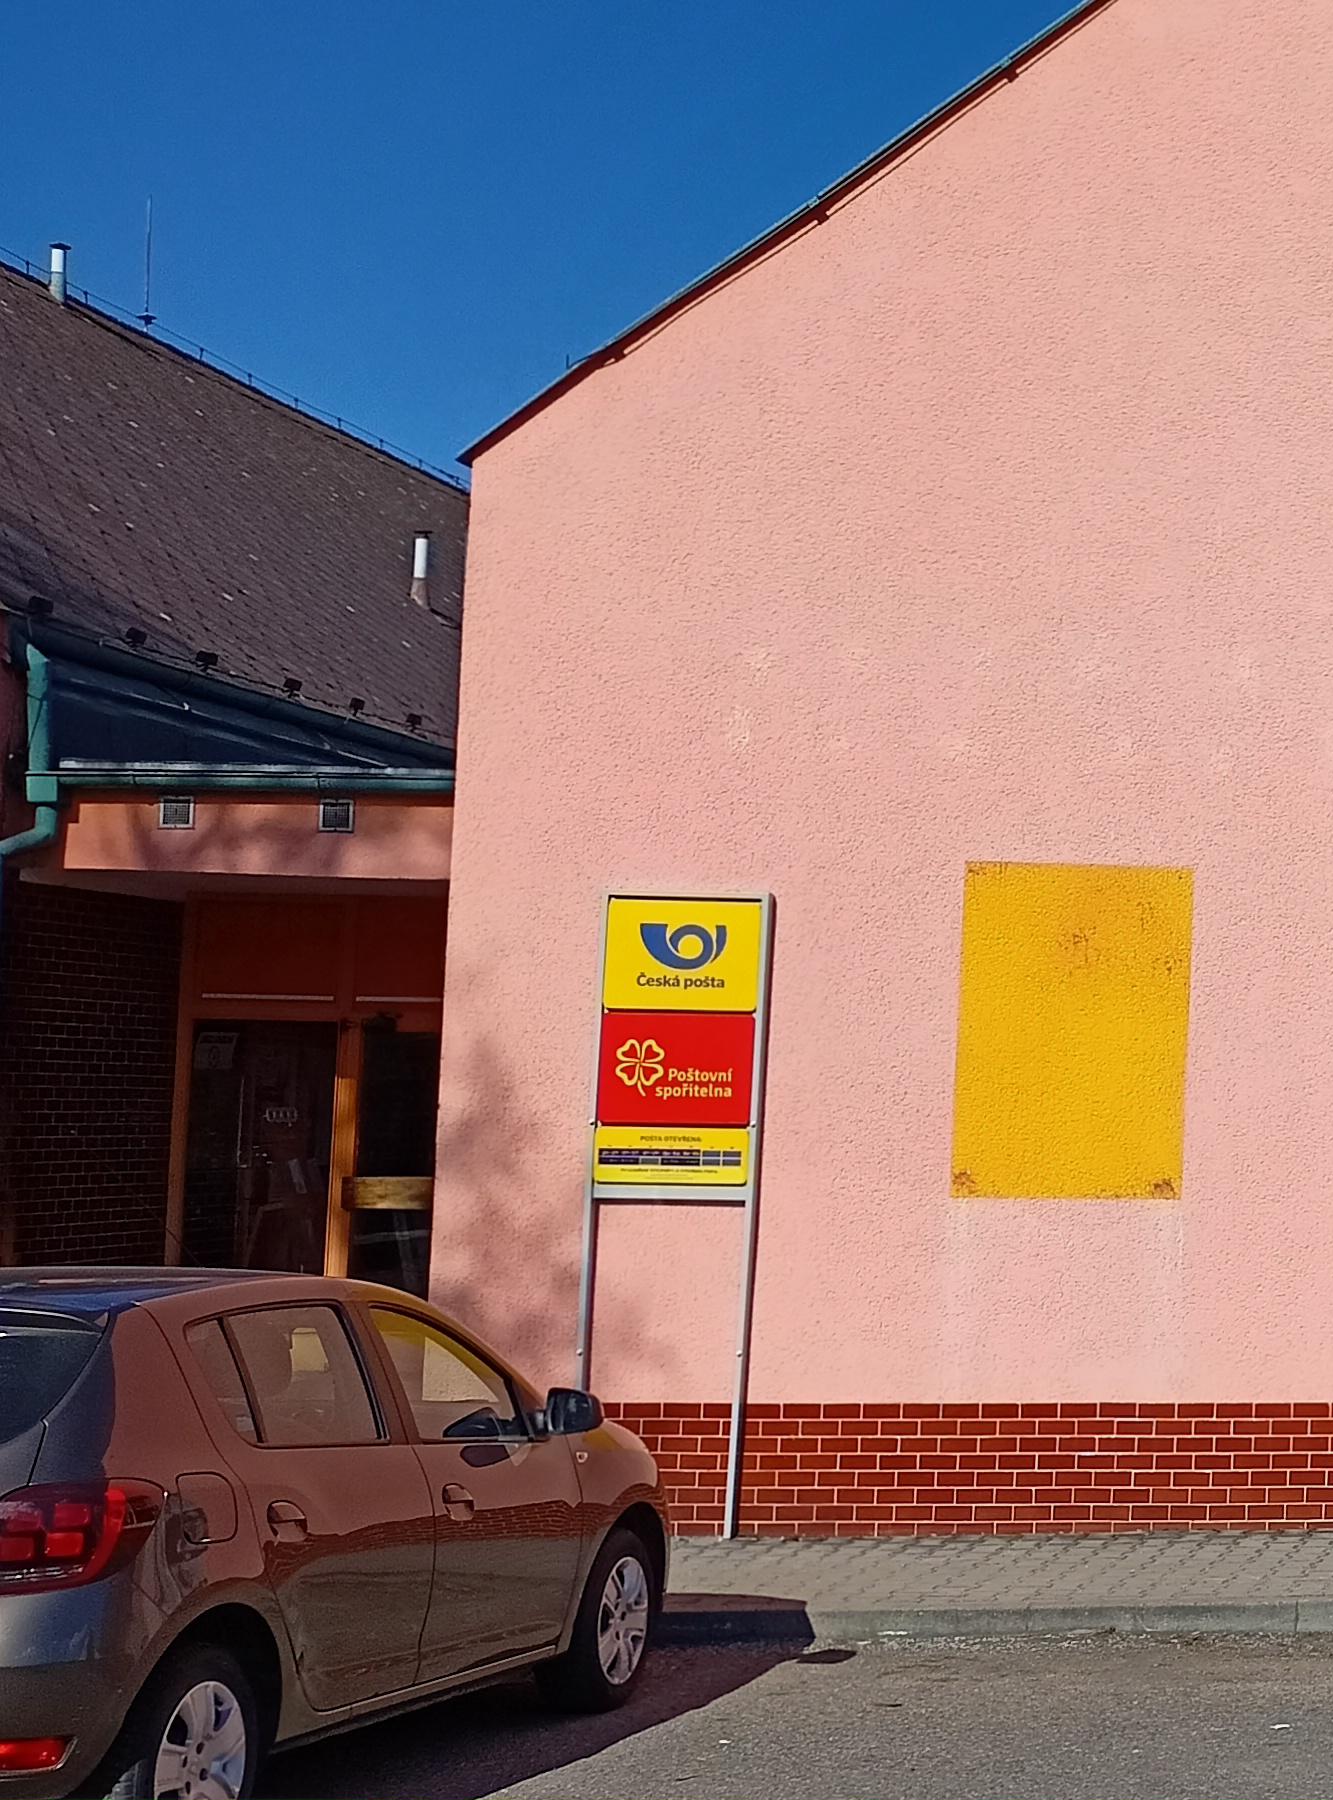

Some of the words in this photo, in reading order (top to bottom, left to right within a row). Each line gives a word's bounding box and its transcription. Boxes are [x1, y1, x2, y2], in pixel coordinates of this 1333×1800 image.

[636, 972, 681, 988] Česká
[683, 975, 725, 990] pošta
[668, 1068, 733, 1083] Poštovní
[655, 1083, 732, 1100] spořitelna
